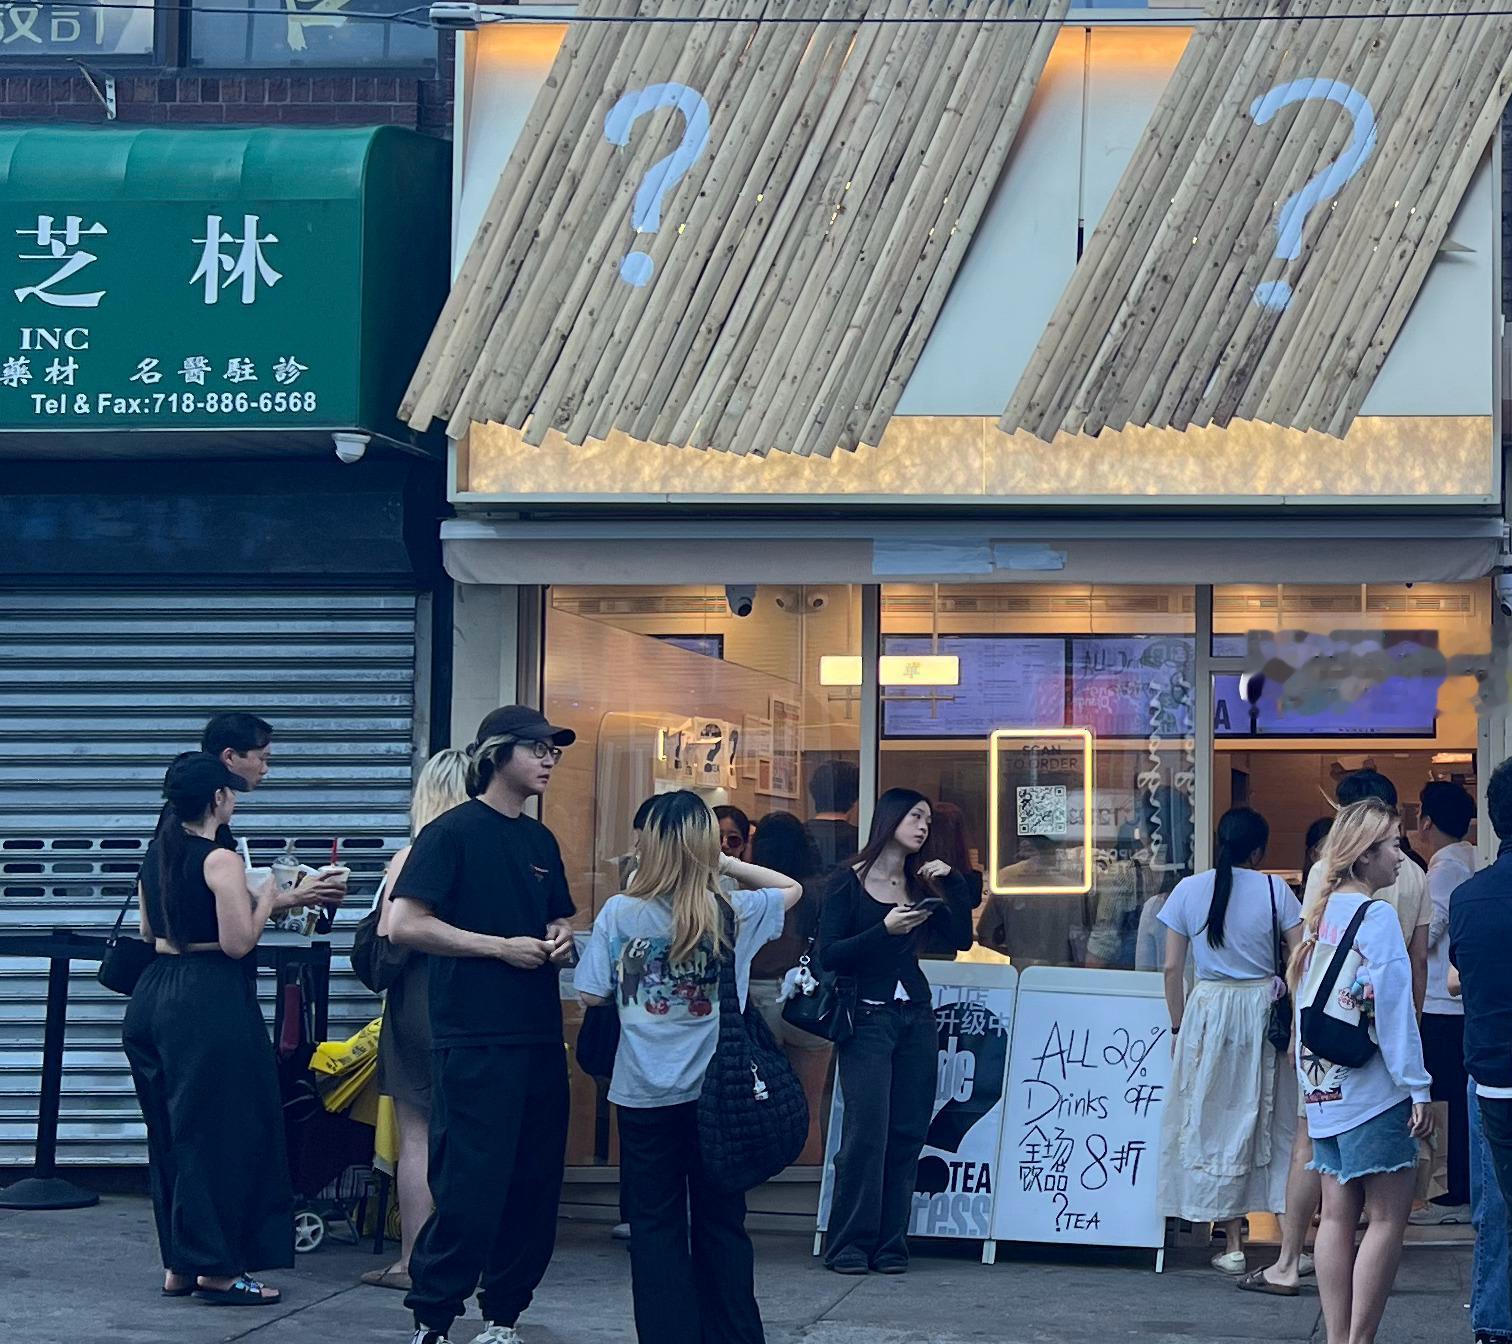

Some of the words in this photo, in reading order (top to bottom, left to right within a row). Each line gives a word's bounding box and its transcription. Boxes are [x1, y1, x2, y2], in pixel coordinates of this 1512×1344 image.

[20, 327, 90, 351] INC
[31, 393, 67, 414] Tel
[73, 393, 91, 414] &
[1029, 758, 1078, 770] ORDER
[1032, 1021, 1098, 1080] ALL
[1103, 1026, 1167, 1083] 20%
[1022, 1079, 1110, 1126] Drinks
